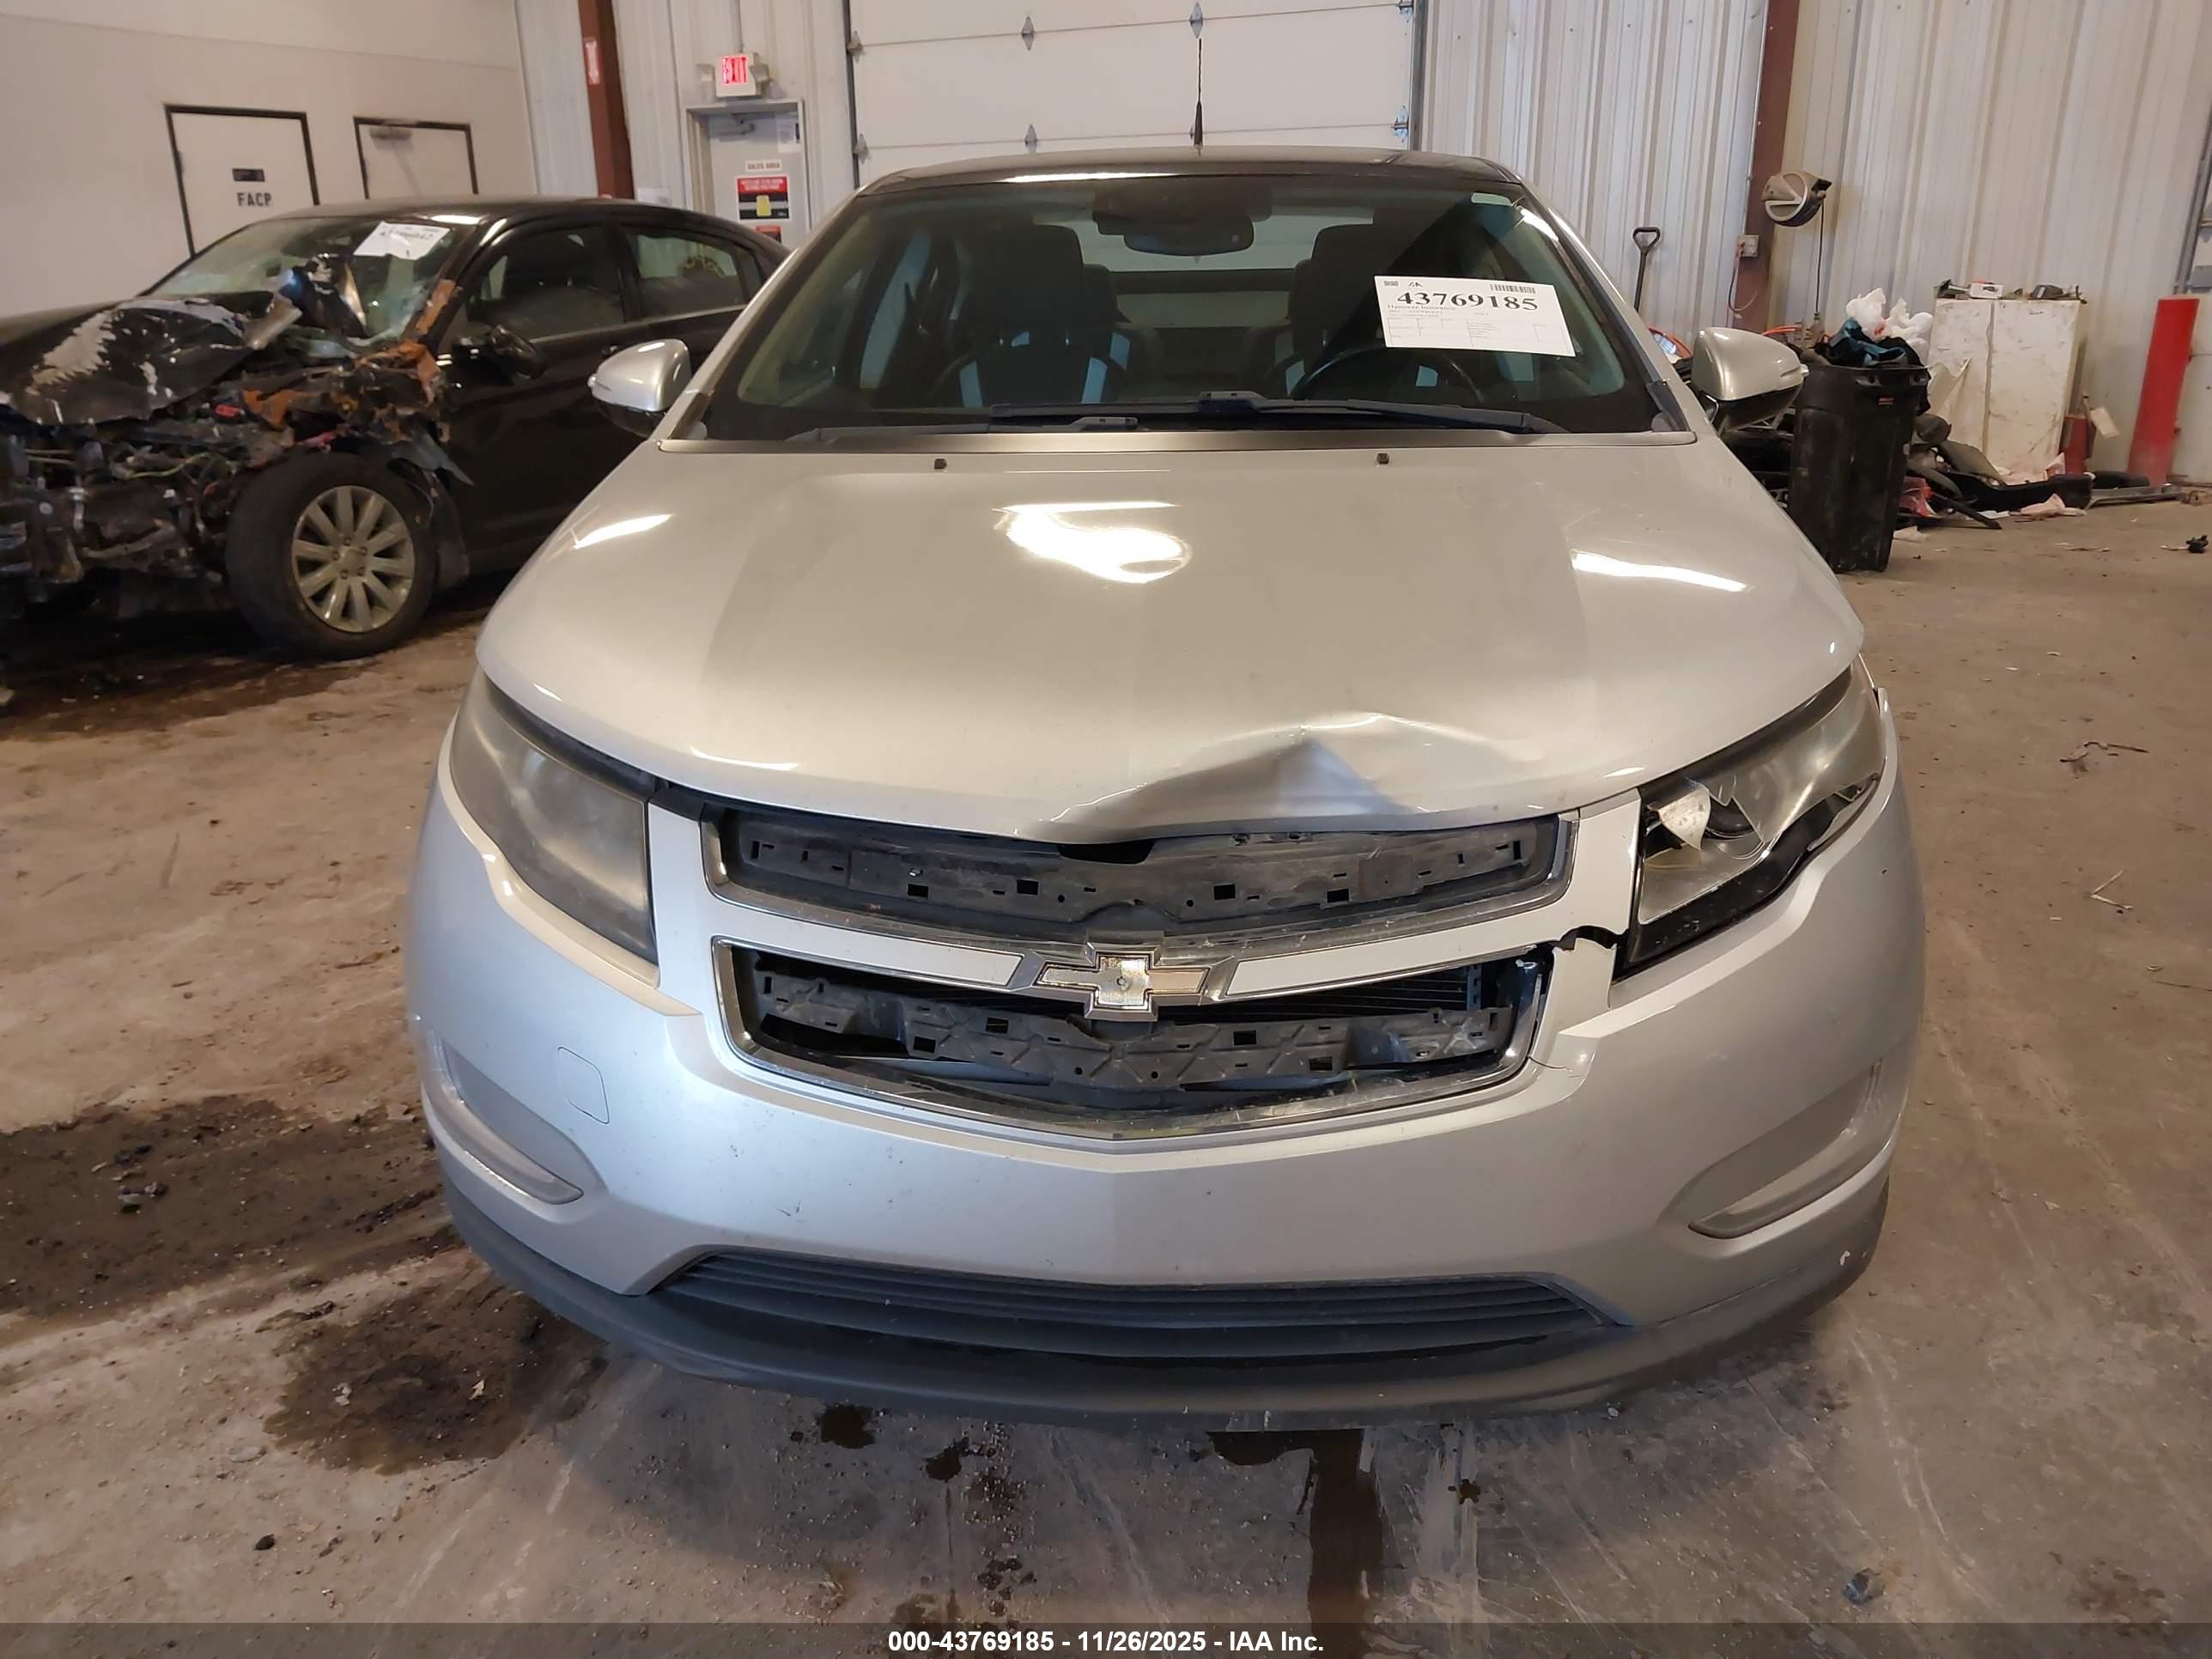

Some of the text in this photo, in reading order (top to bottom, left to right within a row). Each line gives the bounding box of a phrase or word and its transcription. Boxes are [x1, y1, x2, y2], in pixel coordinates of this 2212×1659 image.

[721, 57, 747, 83] EXIT
[236, 192, 272, 206] FACP
[1397, 292, 1538, 311] 43769185
